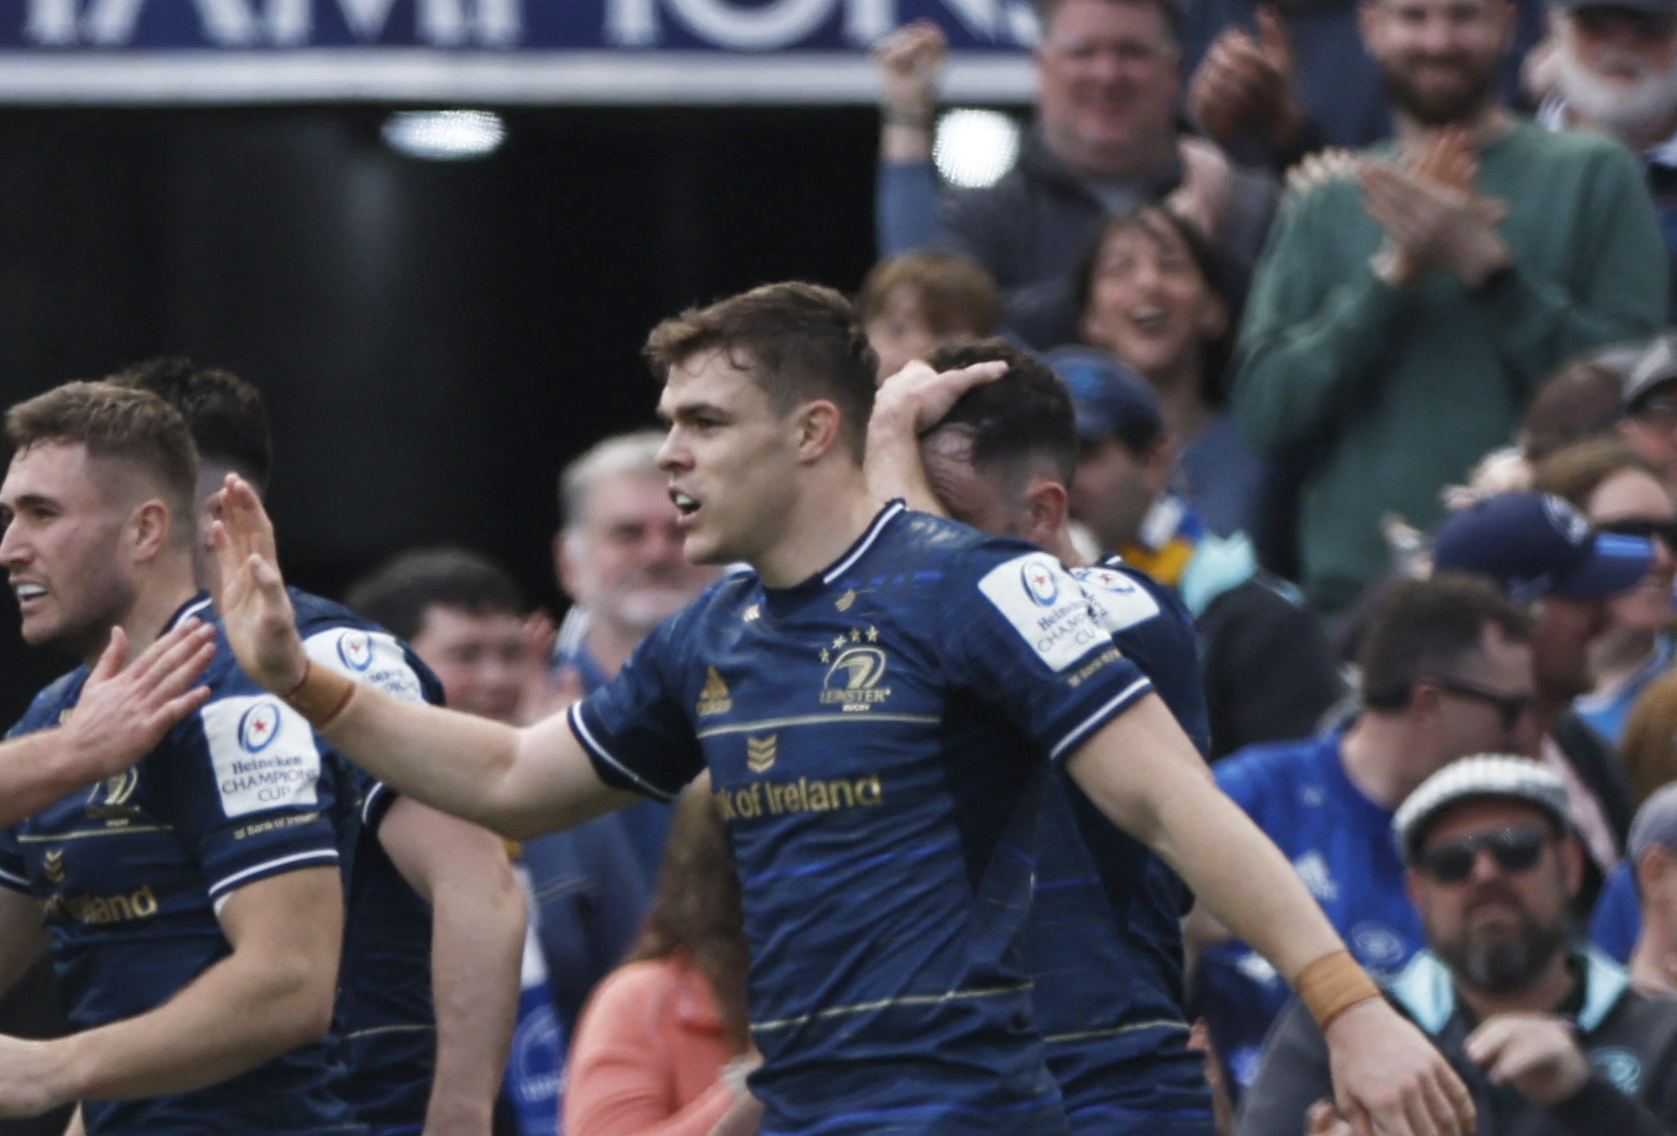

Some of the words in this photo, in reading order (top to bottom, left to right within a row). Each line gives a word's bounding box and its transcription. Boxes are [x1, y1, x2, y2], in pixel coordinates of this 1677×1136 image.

[232, 756, 303, 775] Heineken
[258, 786, 292, 802] CUP
[735, 782, 762, 818] of
[764, 774, 882, 815] Ireland
